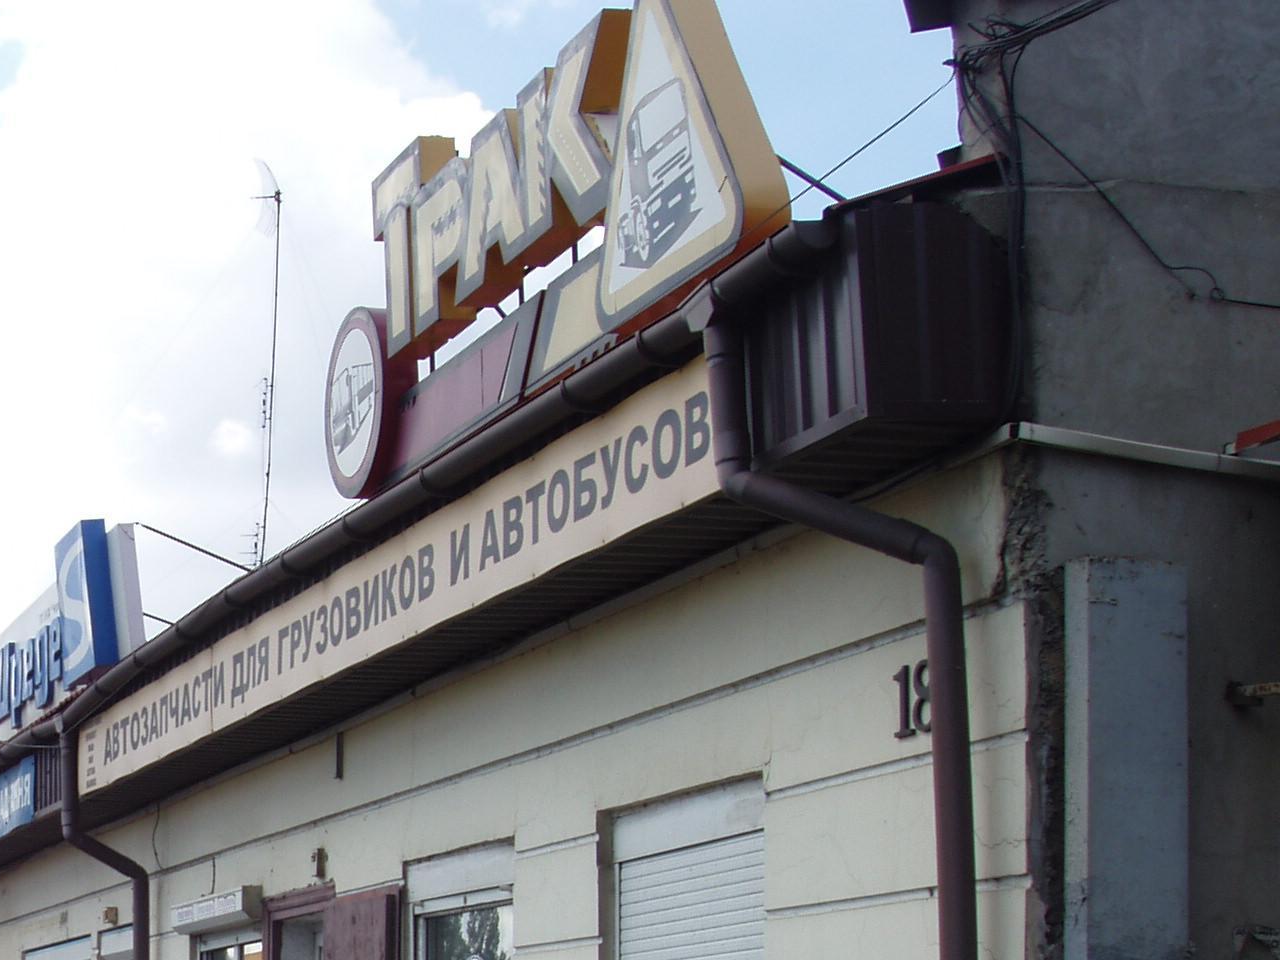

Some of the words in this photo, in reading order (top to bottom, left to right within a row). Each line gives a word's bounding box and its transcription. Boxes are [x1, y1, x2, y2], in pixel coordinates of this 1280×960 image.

[372, 8, 612, 360] ТРАК
[104, 663, 226, 767] АВТОЗАПЧАСТИ
[229, 637, 271, 711] ДЛЯ
[276, 543, 436, 678] ГРУЗОВИКОВ
[448, 522, 471, 589] И
[478, 390, 712, 574] АВТОБУСОВ
